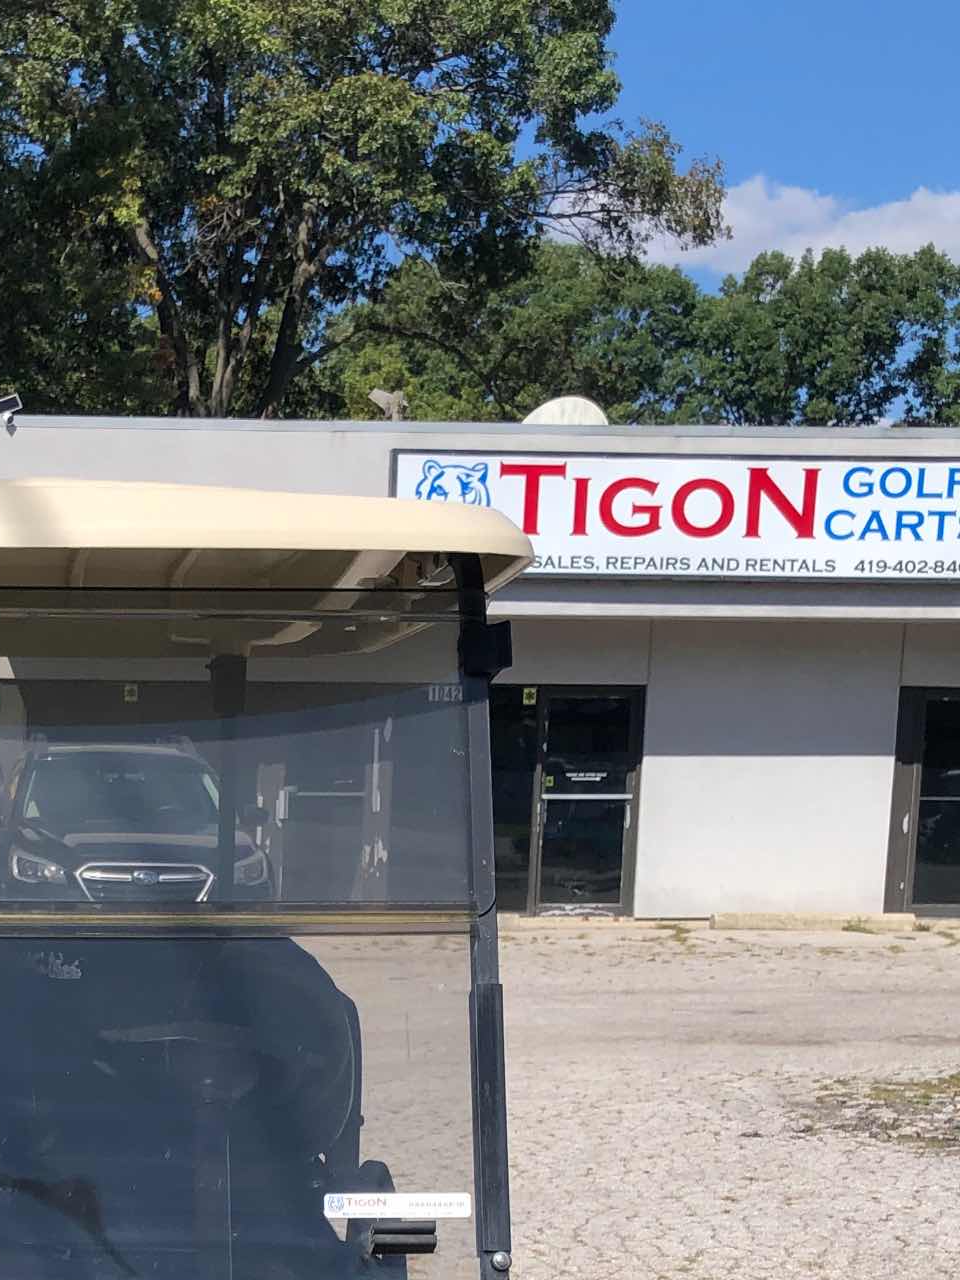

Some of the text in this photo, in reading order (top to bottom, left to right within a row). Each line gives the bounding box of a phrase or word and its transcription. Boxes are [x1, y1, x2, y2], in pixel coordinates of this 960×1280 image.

[500, 461, 822, 539] TIGON
[824, 509, 960, 541] CART
[534, 555, 960, 574] SALES, REPAIRS AND RENTALS 419-402-84
[344, 1197, 387, 1208] TIGON
